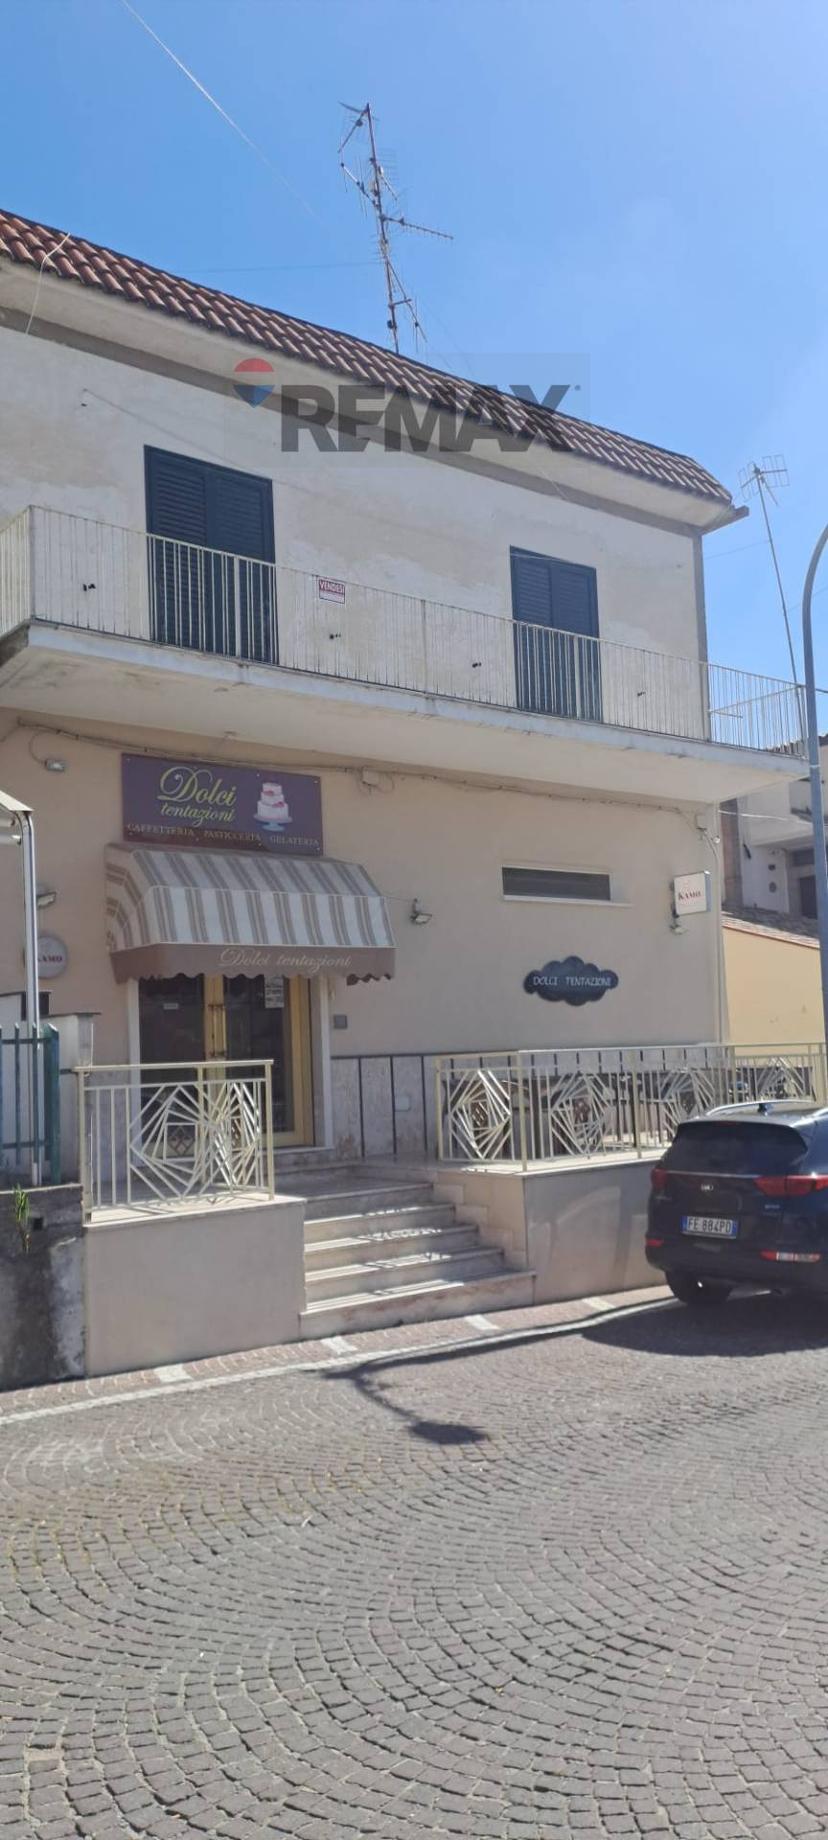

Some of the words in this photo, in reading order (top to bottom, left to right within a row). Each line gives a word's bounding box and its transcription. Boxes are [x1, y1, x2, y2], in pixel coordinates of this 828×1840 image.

[157, 766, 237, 807] Dolci
[160, 802, 235, 828] tentazioni
[127, 823, 194, 837] CAFFETTERIA
[204, 830, 261, 842] PASTICCERIA
[270, 835, 320, 847] GELATERIA
[219, 948, 271, 968] Dolci
[276, 952, 352, 974] tentazioni
[533, 976, 558, 986] DOLCI
[566, 976, 612, 987] TENTAZIONI
[688, 1217, 699, 1231] FE
